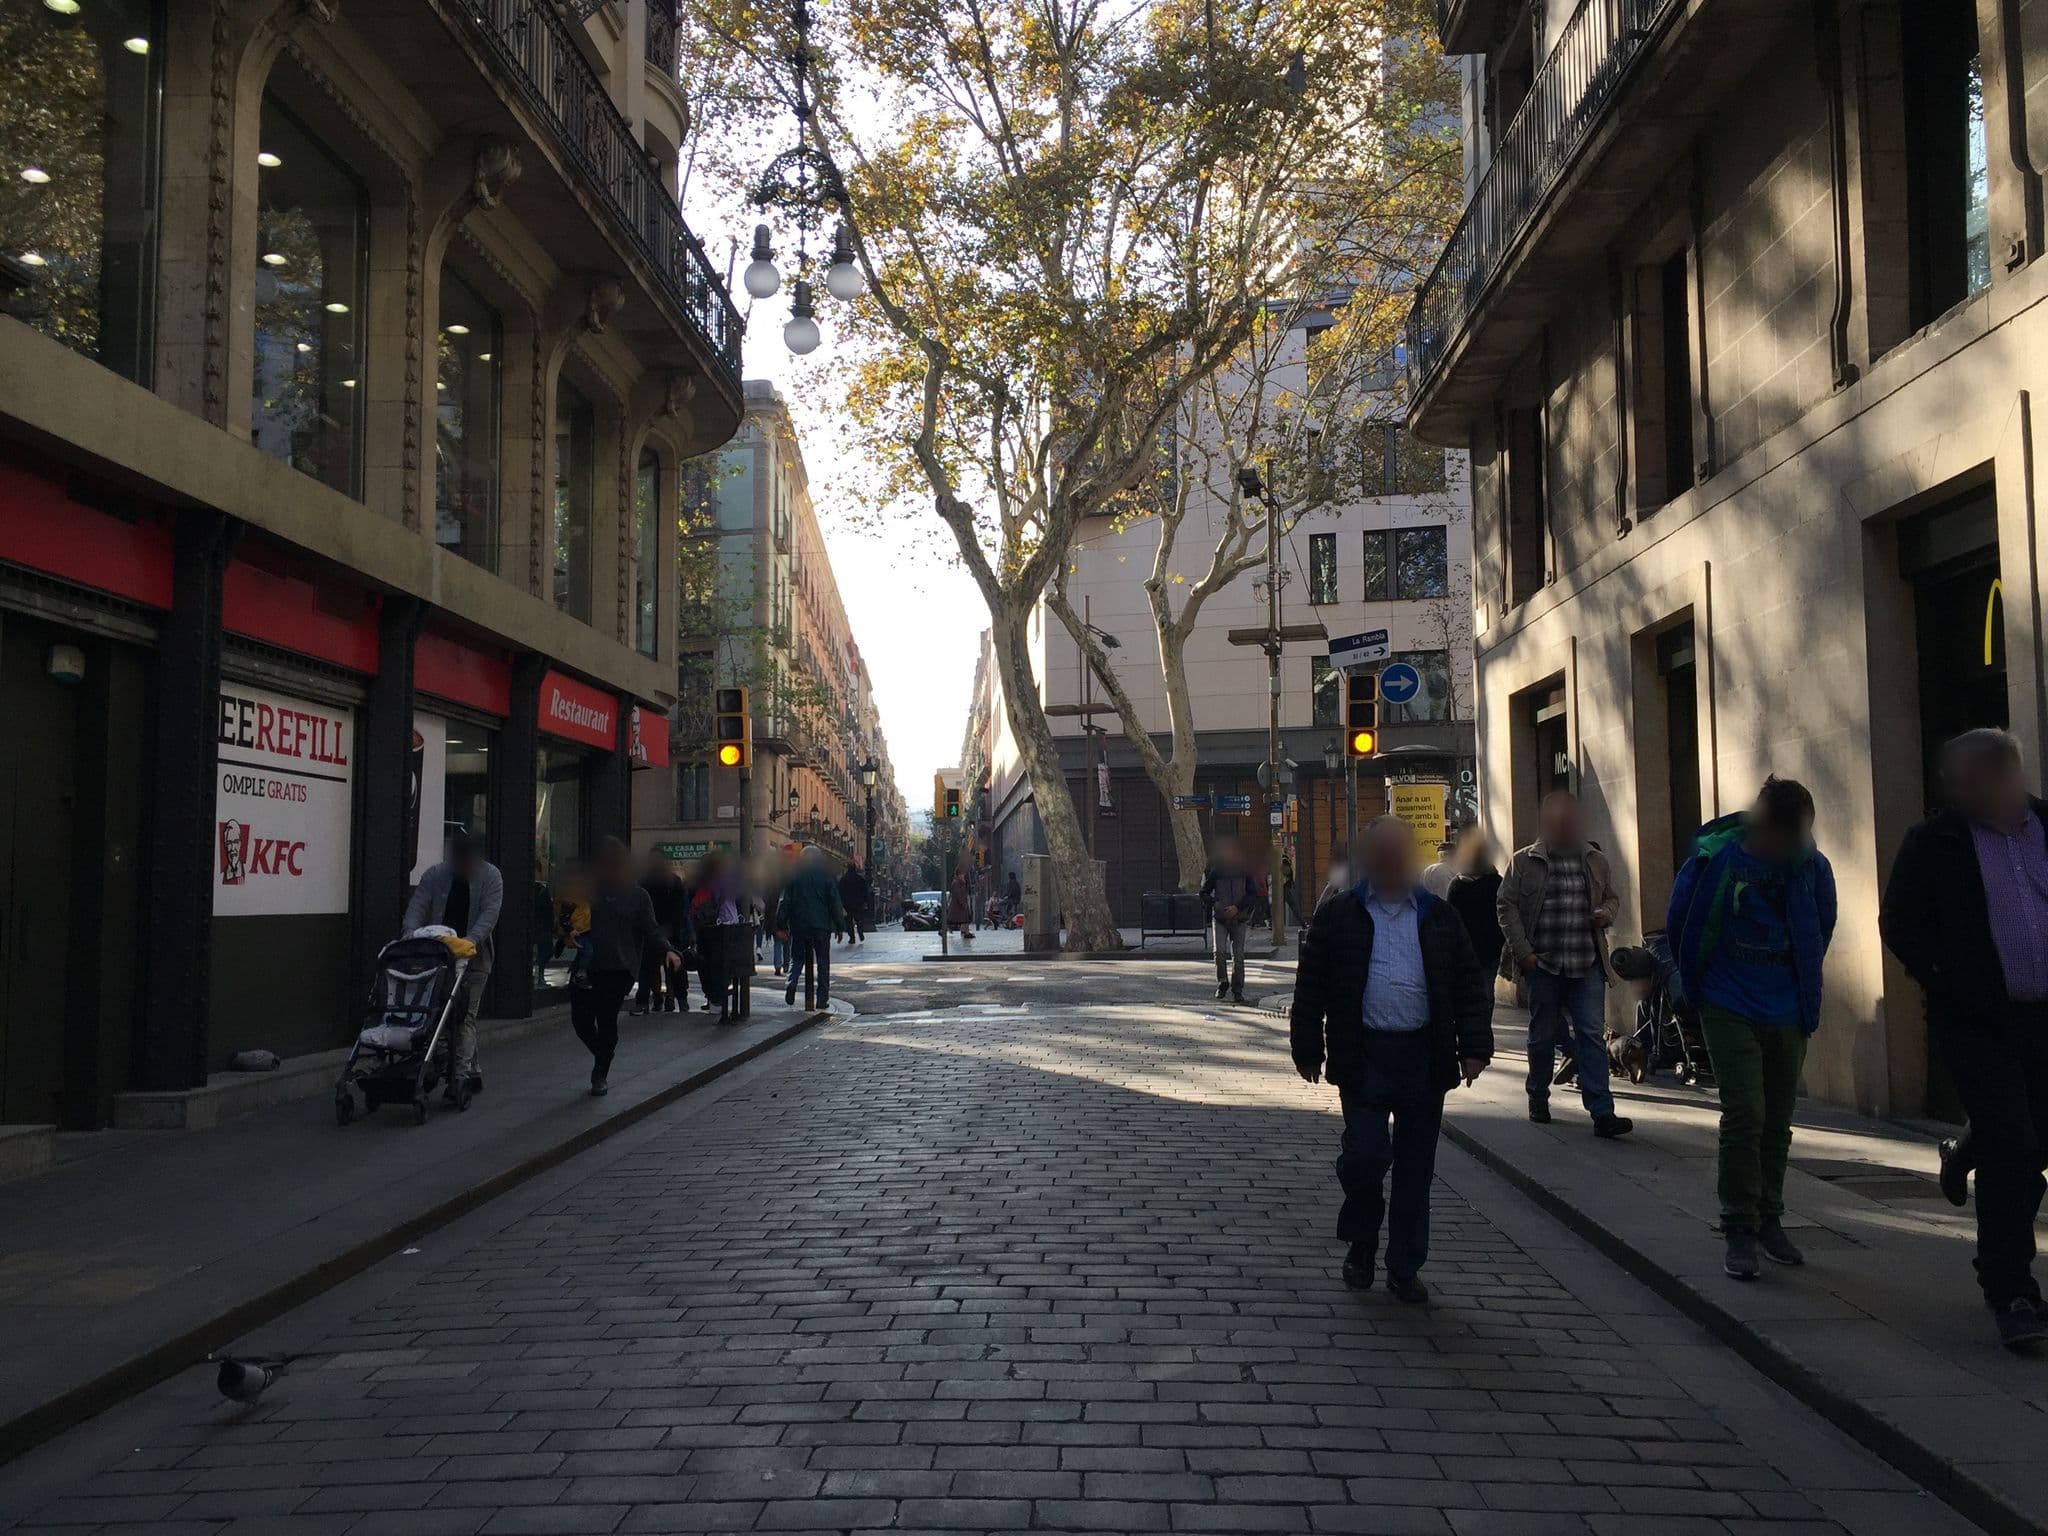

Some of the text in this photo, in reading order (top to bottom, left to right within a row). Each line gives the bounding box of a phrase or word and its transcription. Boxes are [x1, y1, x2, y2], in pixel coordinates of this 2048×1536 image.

[550, 688, 609, 733] Restaurant
[223, 774, 307, 803] OMPLE GRATIS
[249, 838, 305, 876] KFC
